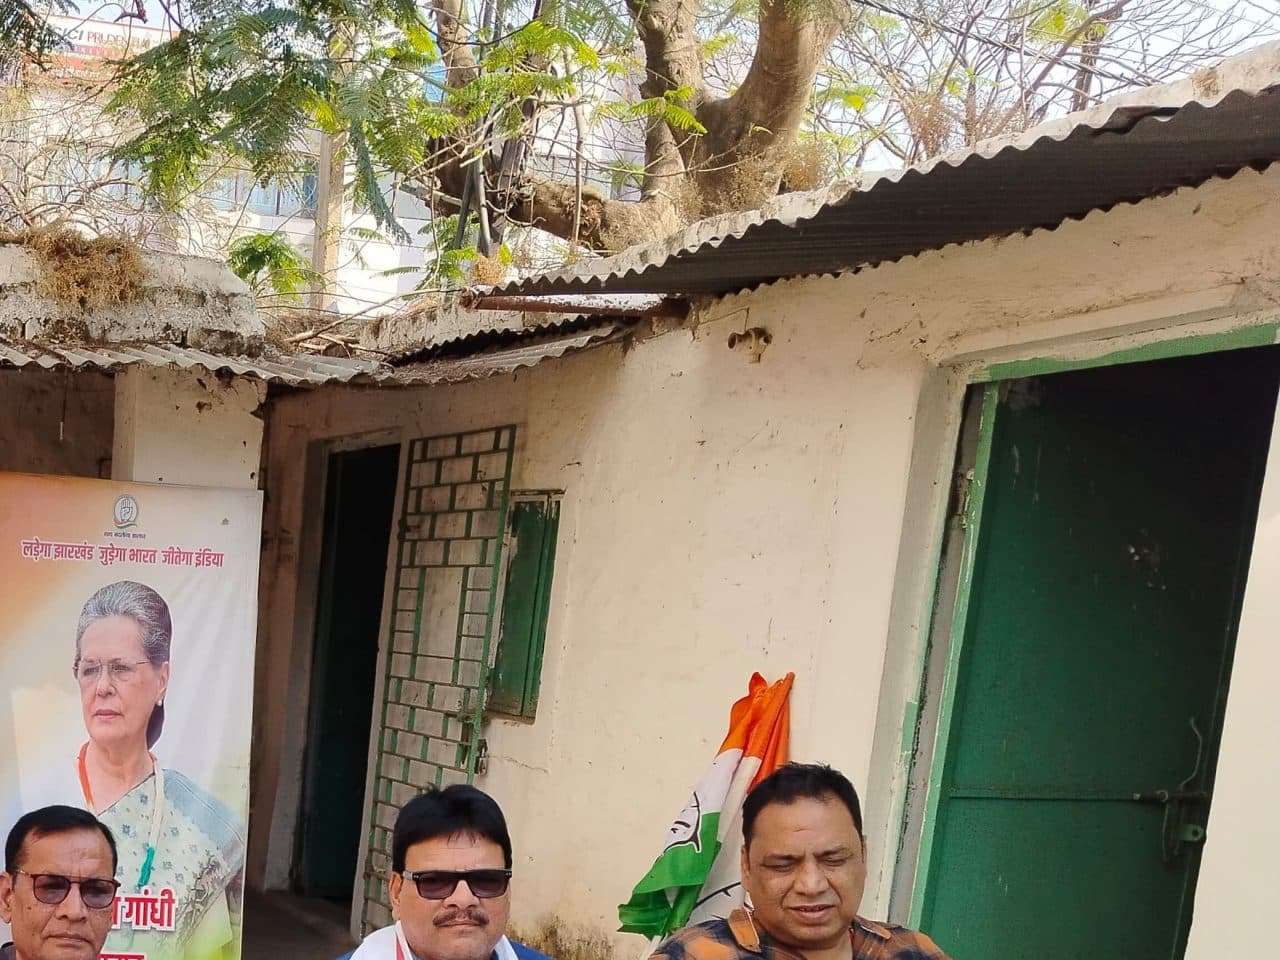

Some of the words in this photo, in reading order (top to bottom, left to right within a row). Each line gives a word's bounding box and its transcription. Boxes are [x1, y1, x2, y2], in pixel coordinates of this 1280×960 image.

[22, 538, 51, 560] लड़ेगा
[53, 542, 94, 560] झारखंड
[98, 543, 127, 565] जुड़ेगा
[129, 547, 157, 564] भारत
[161, 546, 194, 566] जीतेगा
[195, 548, 225, 567] इंडिया
[124, 888, 176, 927] गांधी
